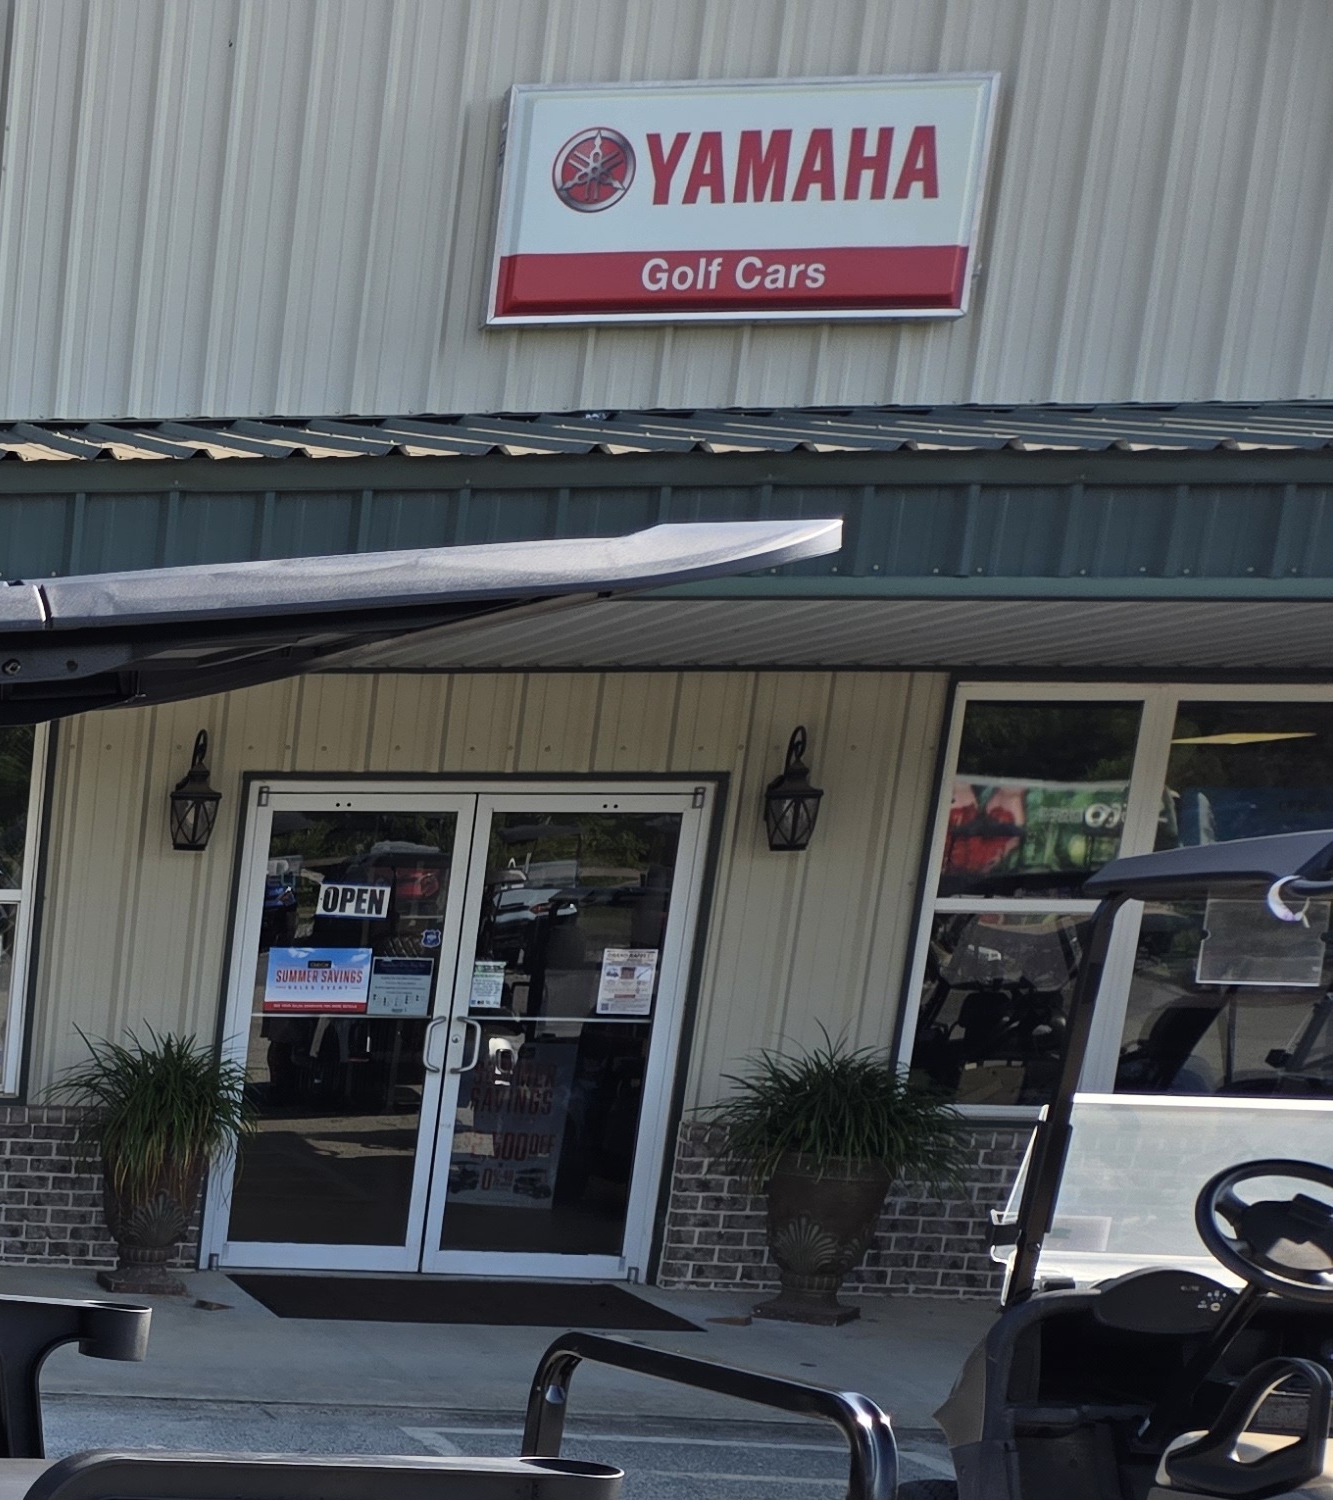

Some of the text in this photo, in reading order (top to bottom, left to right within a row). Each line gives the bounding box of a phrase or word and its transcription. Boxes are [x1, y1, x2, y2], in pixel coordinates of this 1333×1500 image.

[646, 125, 940, 205] YAMAHA
[641, 256, 826, 292] Golf Cars
[322, 886, 386, 915] OPEN
[276, 969, 363, 984] SUMMER SAVINGS
